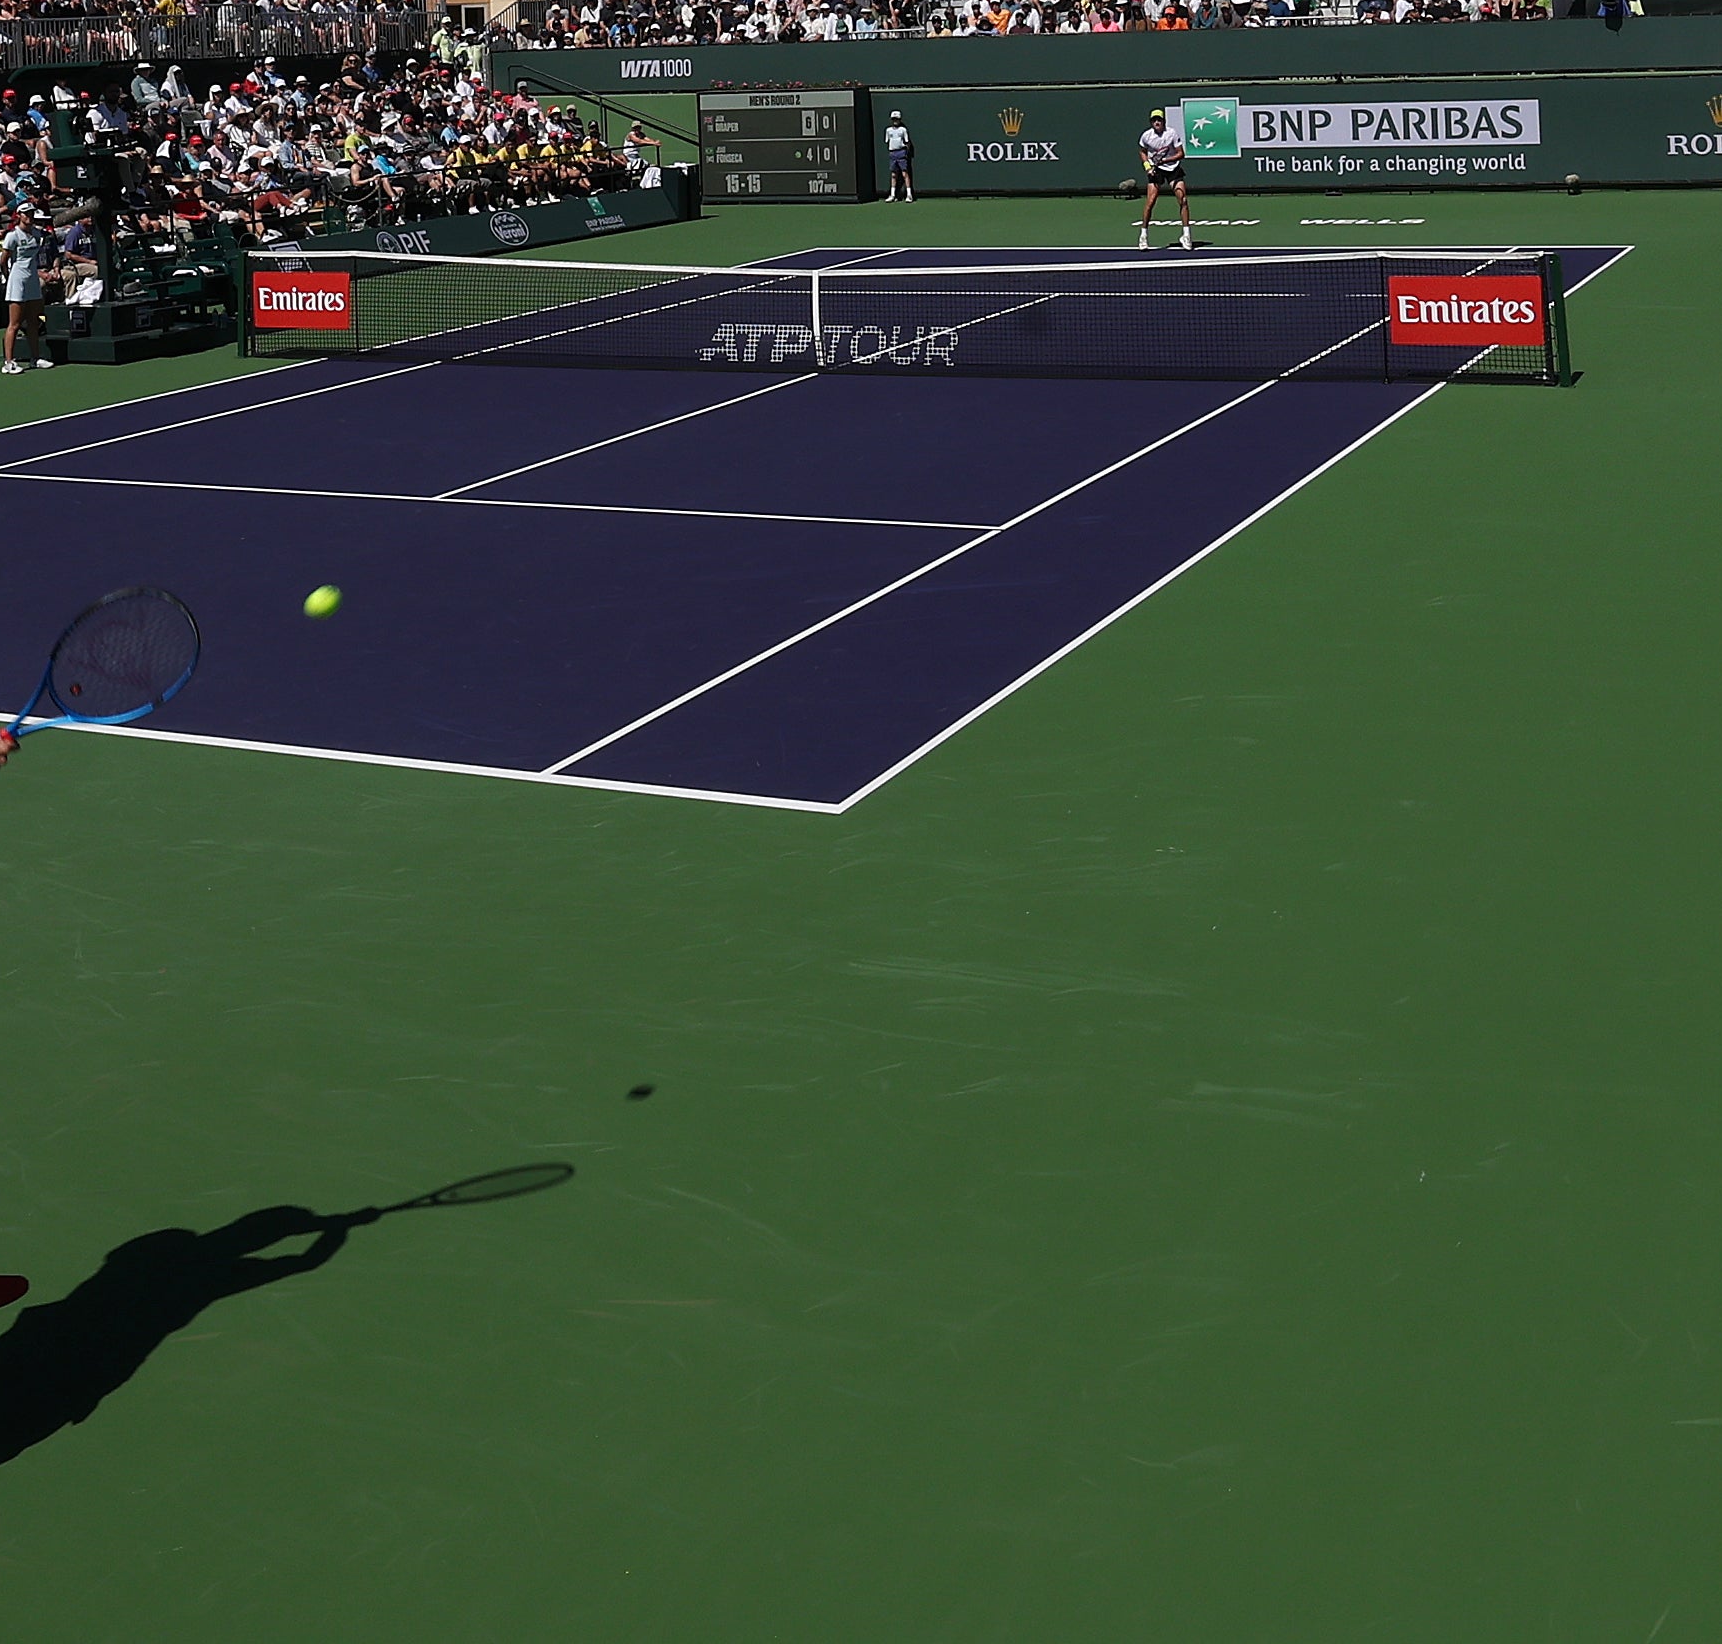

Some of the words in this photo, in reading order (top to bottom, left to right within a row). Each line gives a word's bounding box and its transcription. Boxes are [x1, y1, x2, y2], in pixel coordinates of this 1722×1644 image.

[749, 95, 770, 107] MEN'S
[770, 94, 796, 106] ROUND
[795, 94, 801, 105] 2
[822, 115, 830, 129] 0
[1252, 110, 1332, 142] BNP
[1351, 105, 1524, 141] PARIBAS
[806, 147, 813, 161] 4
[823, 147, 831, 162] 0
[967, 141, 1059, 162] ROLEX
[1254, 157, 1286, 172] The
[1292, 155, 1333, 172] bank
[1338, 156, 1364, 175] for
[1370, 159, 1380, 172] a
[1385, 154, 1467, 175] changing
[1472, 154, 1526, 171] world
[398, 230, 430, 254] PIF
[258, 287, 345, 311] Emirates
[1397, 294, 1535, 325] Emirates
[695, 323, 813, 363] ATP
[823, 324, 958, 366] TOUR
